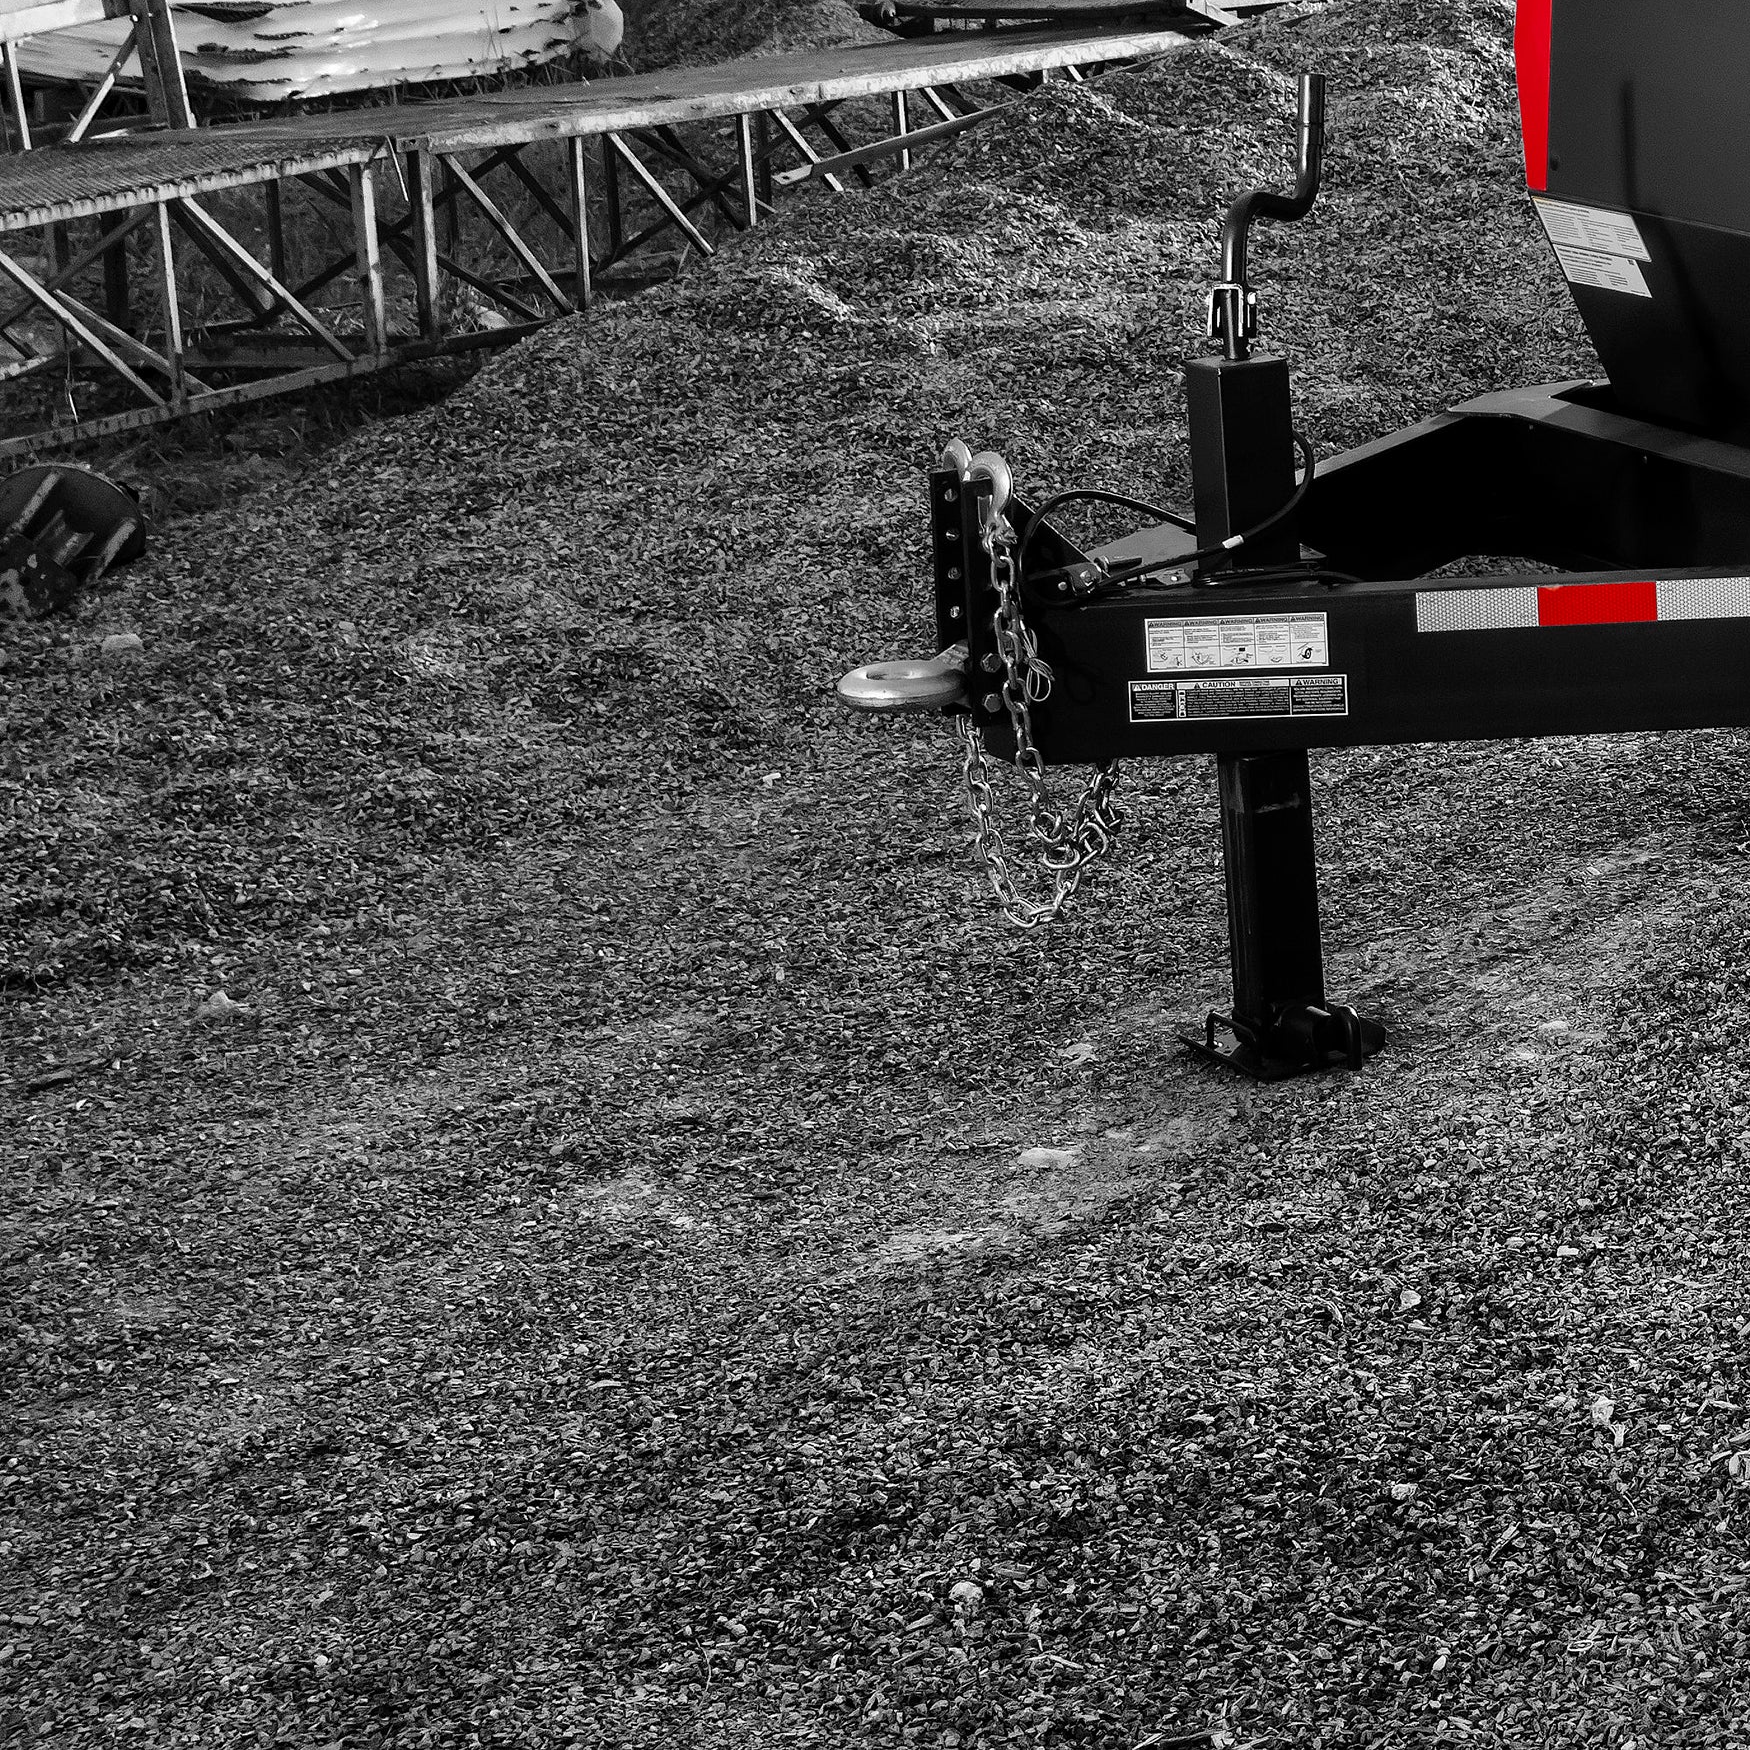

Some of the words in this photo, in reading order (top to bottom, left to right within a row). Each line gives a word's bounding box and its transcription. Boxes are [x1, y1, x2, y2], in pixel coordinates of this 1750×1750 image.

[1202, 681, 1236, 689] CAUTION
[1303, 678, 1339, 686] WARNING
[1141, 682, 1175, 691] DANGER
